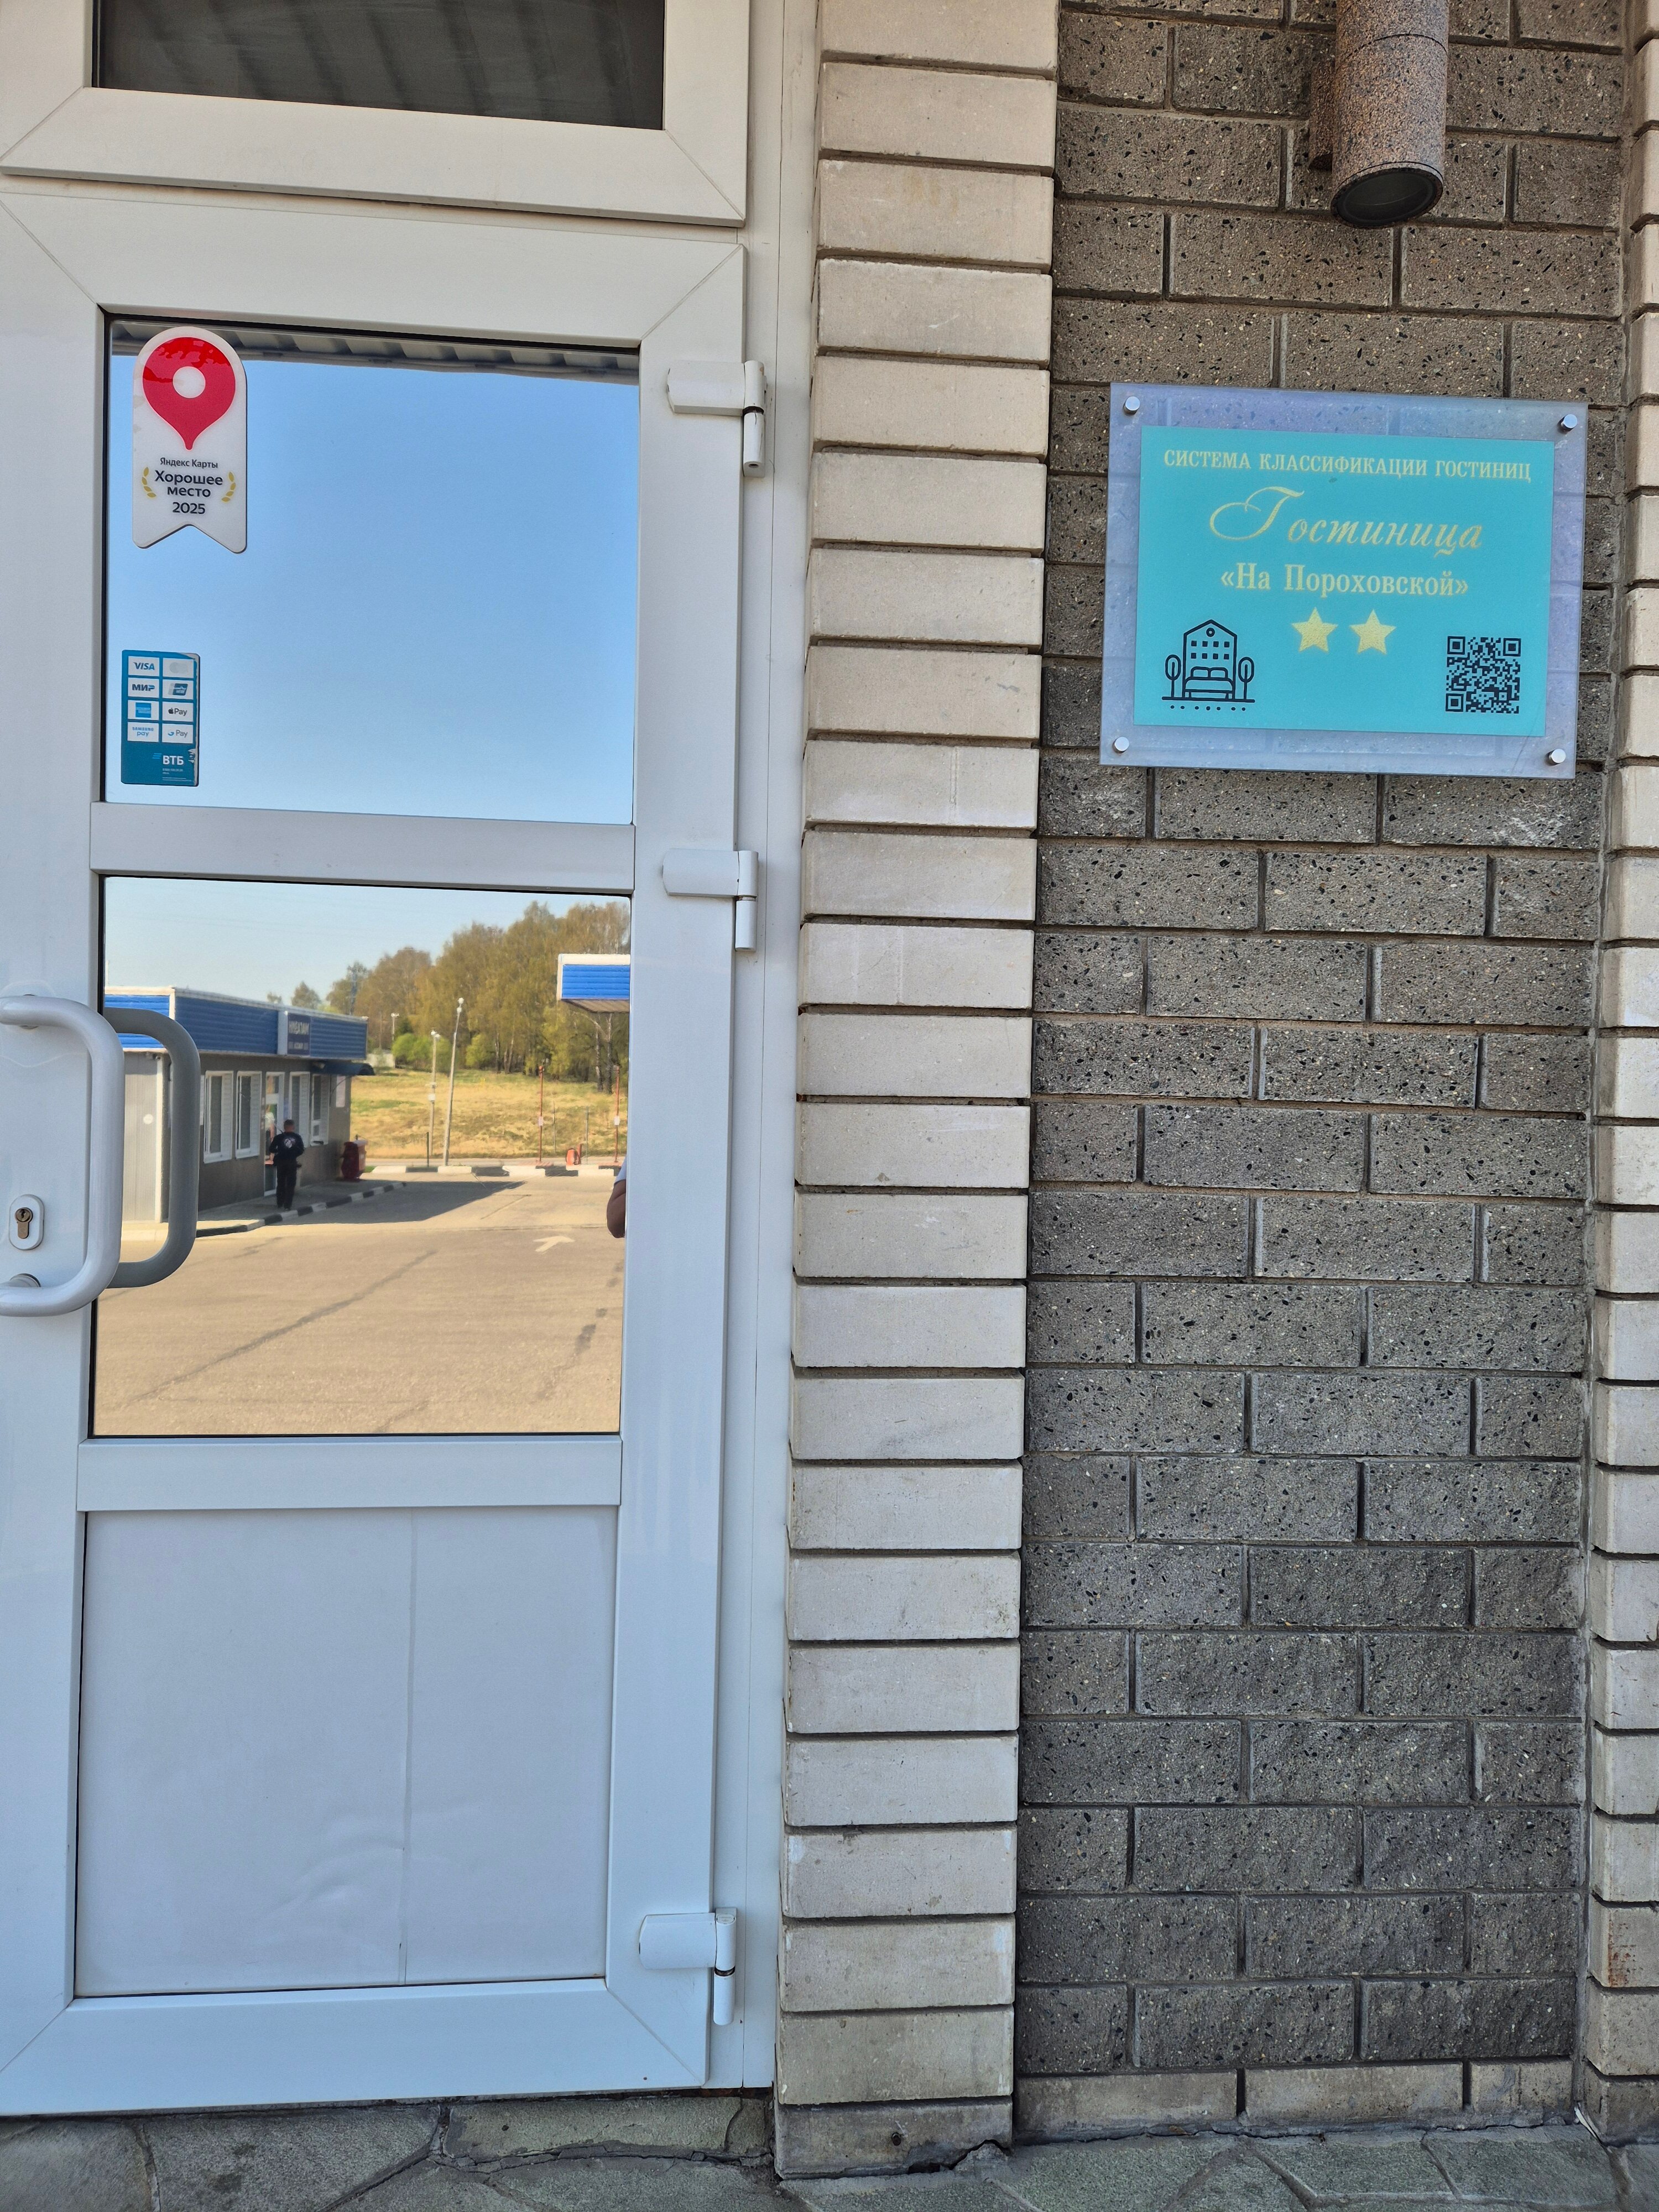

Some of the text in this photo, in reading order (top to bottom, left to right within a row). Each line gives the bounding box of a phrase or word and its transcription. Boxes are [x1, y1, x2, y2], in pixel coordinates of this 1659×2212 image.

[160, 457, 218, 469] Яндекс Карты
[1164, 449, 1531, 483] СИСТЕМА КЛАССИФИКАЦИИ ГОСТИНИЦ
[154, 469, 223, 486] Хорошее
[167, 487, 211, 497] место
[172, 502, 206, 514] 2025
[1209, 486, 1483, 557] Гостиница
[1220, 563, 1469, 598] «На Пороховской»
[133, 662, 155, 670] VISA
[174, 708, 187, 716] Pay
[176, 729, 188, 738] Pay
[163, 755, 184, 765] ВТБ
